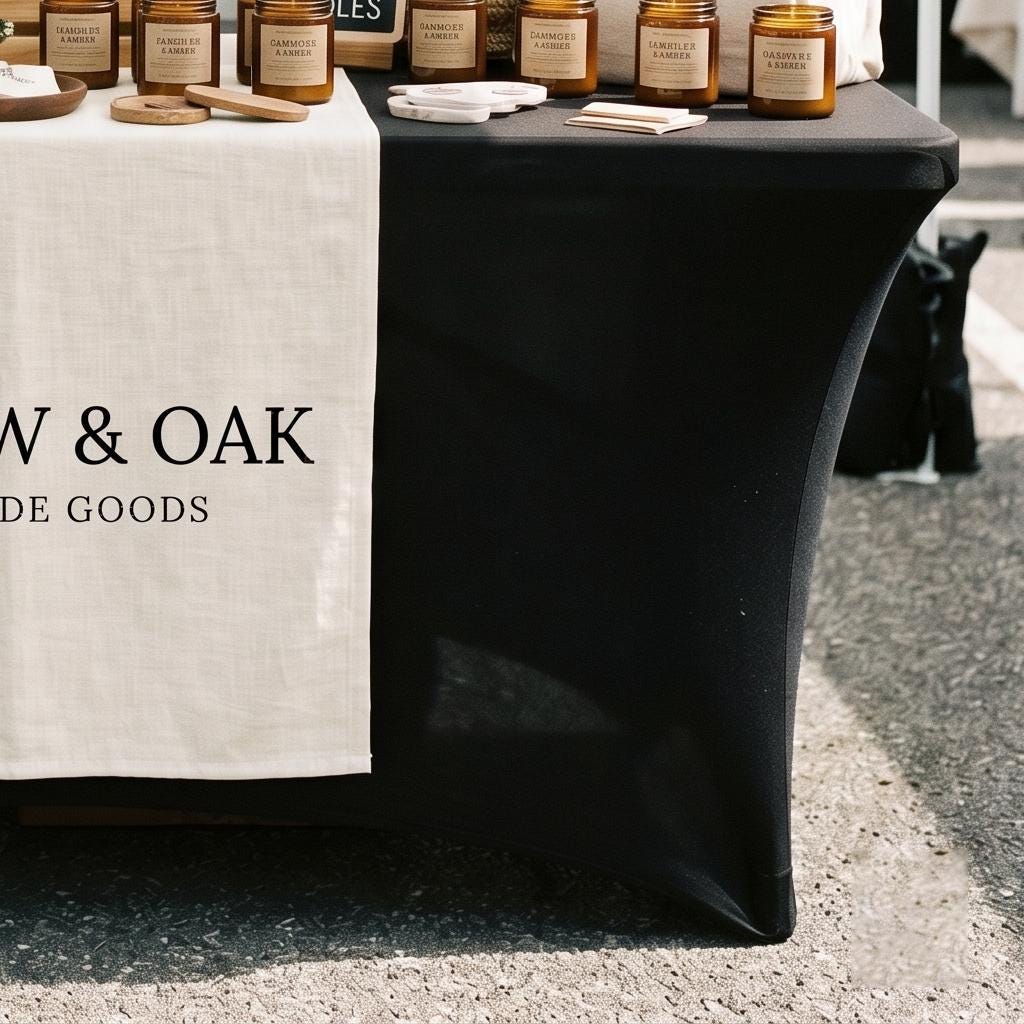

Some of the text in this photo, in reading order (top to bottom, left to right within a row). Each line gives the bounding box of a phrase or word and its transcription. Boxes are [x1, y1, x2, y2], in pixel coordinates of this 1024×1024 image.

[74, 405, 128, 466] &
[151, 404, 315, 466] OAK
[67, 495, 210, 524] GOODS
